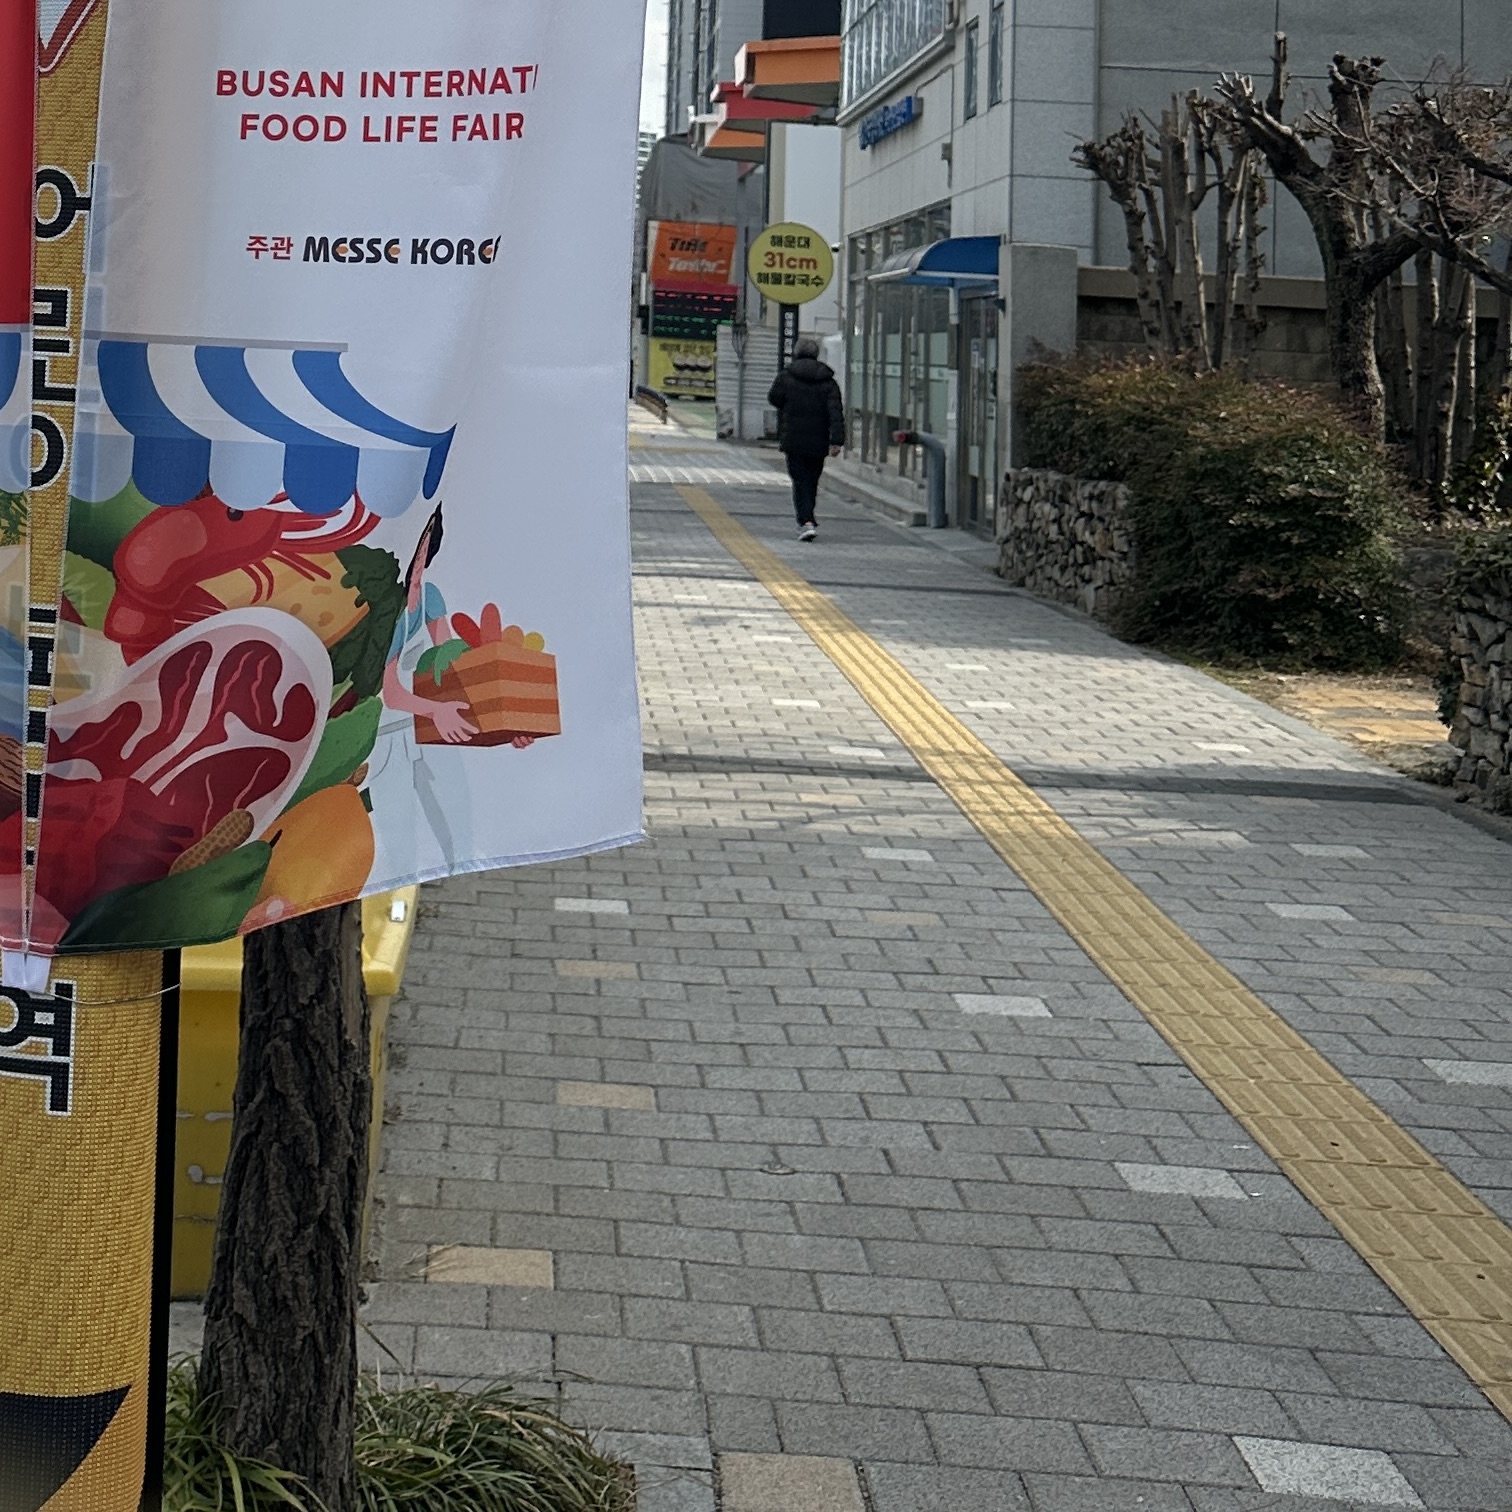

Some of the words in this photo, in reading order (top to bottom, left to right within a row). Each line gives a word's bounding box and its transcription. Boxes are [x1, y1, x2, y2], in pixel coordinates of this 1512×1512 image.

[215, 68, 345, 98] BUSAN
[359, 63, 539, 99] INTERNAT
[240, 112, 348, 143] FOOD
[361, 114, 439, 143] LIFE
[451, 111, 525, 142] FAIR
[246, 234, 295, 261] 주관
[302, 235, 401, 265] MESSE
[770, 233, 811, 251] 해운대
[763, 251, 818, 270] 31cm
